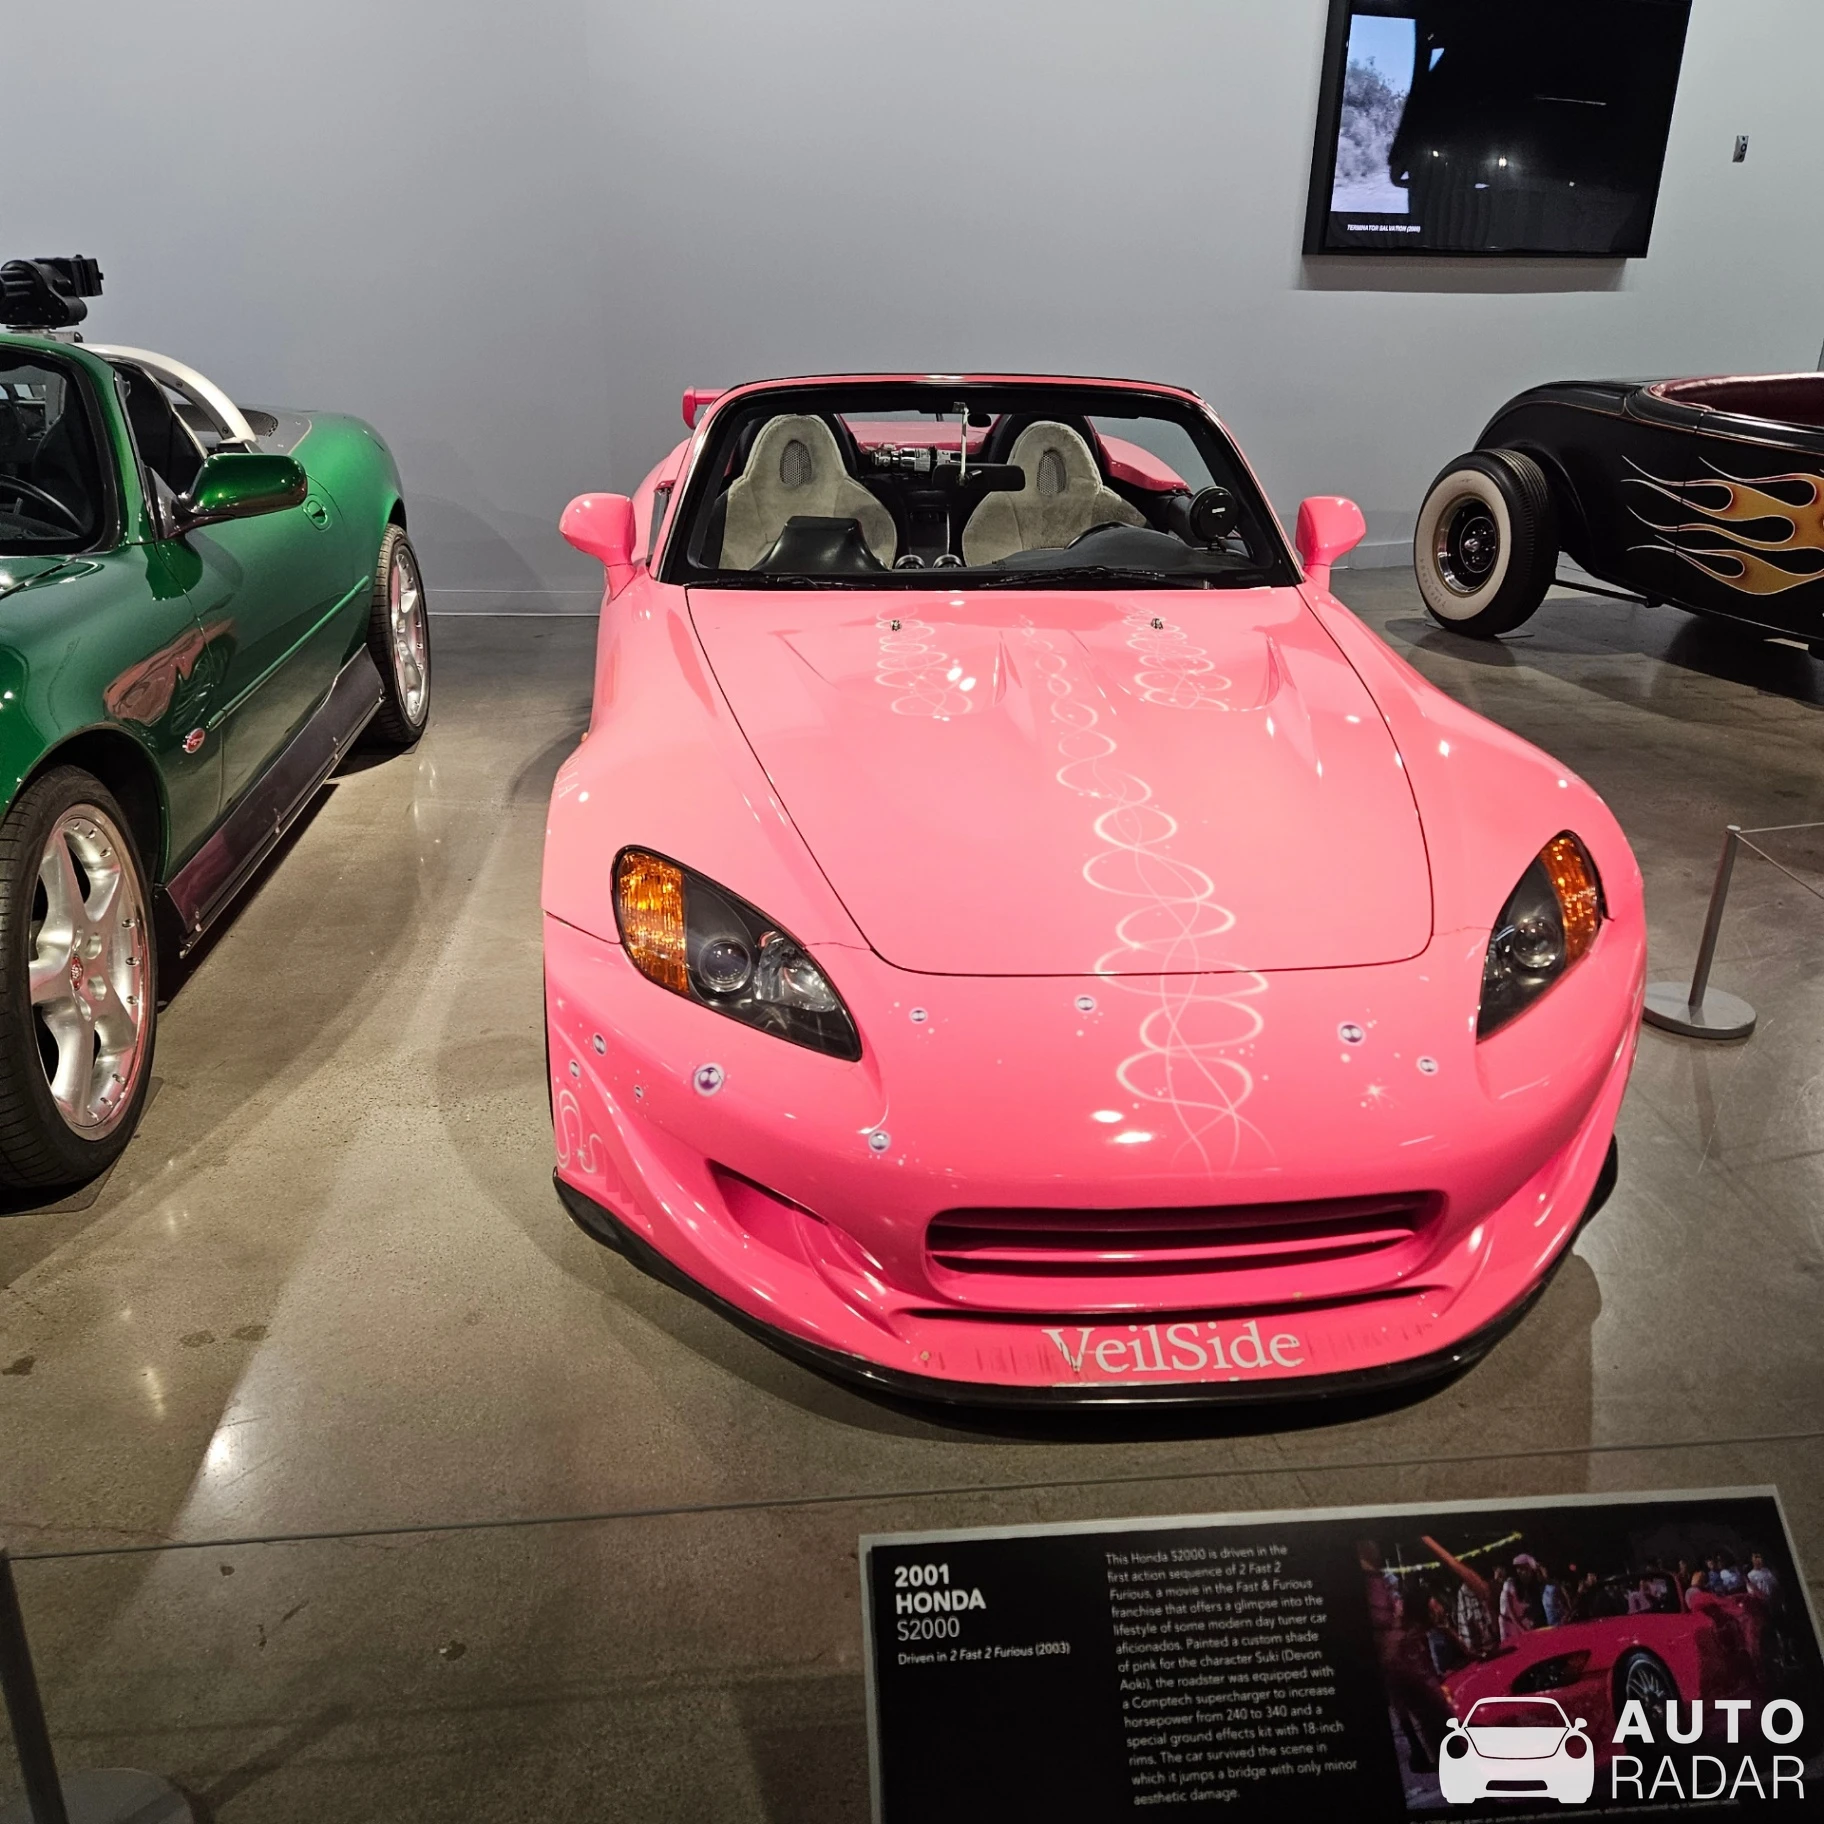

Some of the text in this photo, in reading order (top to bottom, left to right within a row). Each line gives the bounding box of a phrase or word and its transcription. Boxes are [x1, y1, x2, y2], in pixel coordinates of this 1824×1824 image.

[1041, 1319, 1304, 1373] VeilSide
[1105, 1545, 1288, 1564] This Honda S2000 is driven in the
[894, 1563, 949, 1588] 2001
[1108, 1561, 1281, 1582] first action sequence of 2 Fast 2
[895, 1588, 987, 1614] HONDA
[1156, 1590, 1163, 1598] a
[1165, 1586, 1199, 1596] movie
[1202, 1584, 1212, 1594] in
[1215, 1583, 1234, 1594] the
[1236, 1581, 1258, 1592] Fast
[1262, 1580, 1270, 1590] &
[1273, 1580, 1312, 1590] Furious
[1112, 1594, 1323, 1618] franchise that offers a glimpse into the
[897, 1616, 960, 1641] S2000
[1113, 1614, 1327, 1638] lifestyle of some modern day tuner car
[898, 1641, 1070, 1665] Driven in 2 Fast 2 Furious (2003)
[1116, 1630, 1318, 1654] aficionados. Painted a custom shade
[1118, 1649, 1322, 1674] of pink for the character Suki (Devon
[1156, 1678, 1174, 1688] the
[1178, 1674, 1224, 1687] roadster
[1228, 1674, 1249, 1683] was
[1252, 1667, 1307, 1684] equipped
[1310, 1666, 1334, 1678] with
[1122, 1686, 1335, 1710] a Comptech supercharger to increase
[1124, 1703, 1322, 1729] horsepower from 240 to 340 and a
[1126, 1721, 1344, 1749] special ground effects kit with 18-inch
[1129, 1742, 1327, 1766] rims. The car survived the scene in
[1132, 1759, 1357, 1785] which it jumps a bridge with only minor
[1134, 1788, 1240, 1805] aesthetic damage.
